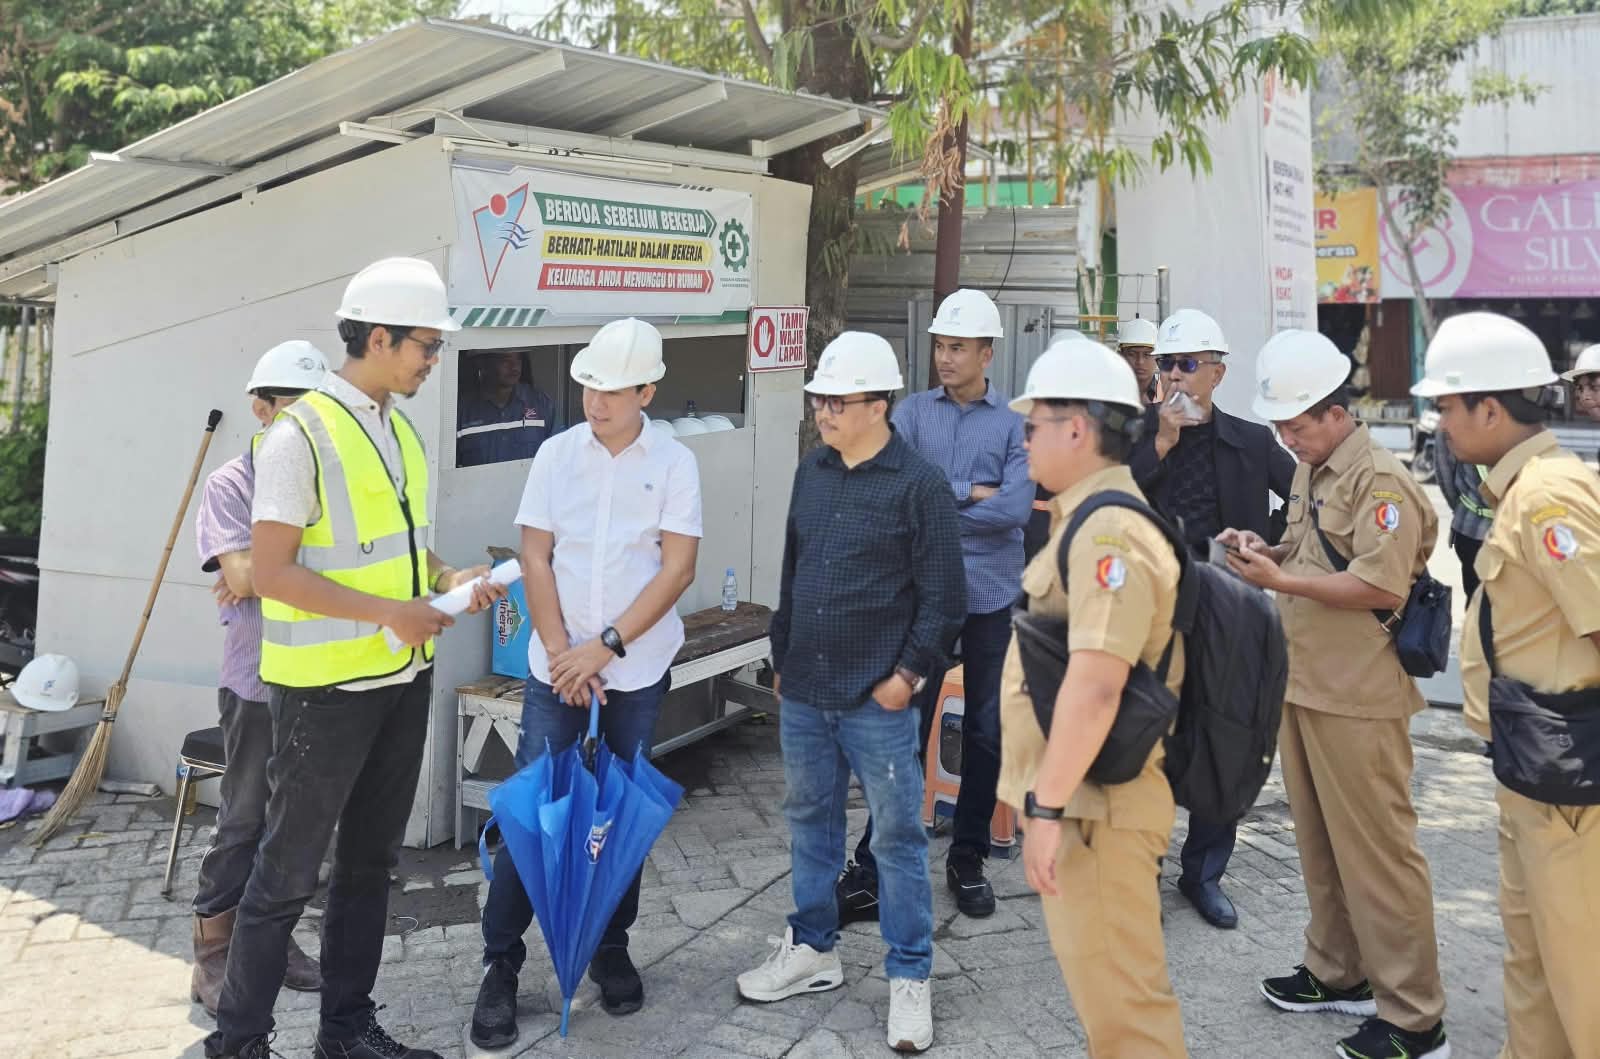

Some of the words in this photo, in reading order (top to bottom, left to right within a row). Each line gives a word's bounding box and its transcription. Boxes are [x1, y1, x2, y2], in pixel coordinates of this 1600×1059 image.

[545, 199, 601, 225] BERDOA
[603, 205, 658, 229] SEBELUM
[660, 210, 707, 234] BEKERJA
[1480, 191, 1600, 232] GAL
[547, 235, 638, 259] BERHATI-HATILAH
[639, 241, 670, 260] DALAM
[671, 244, 703, 262] BEKERJA
[547, 268, 596, 286] KELUARGA
[598, 270, 622, 287] ANDA
[623, 271, 667, 289] MENUNGGU
[667, 274, 676, 289] DI
[677, 274, 703, 289] RUMAH
[780, 312, 804, 329] TAMU
[779, 330, 804, 346] WAJIB
[779, 346, 803, 362] LAPOR
[507, 608, 517, 625] Le
